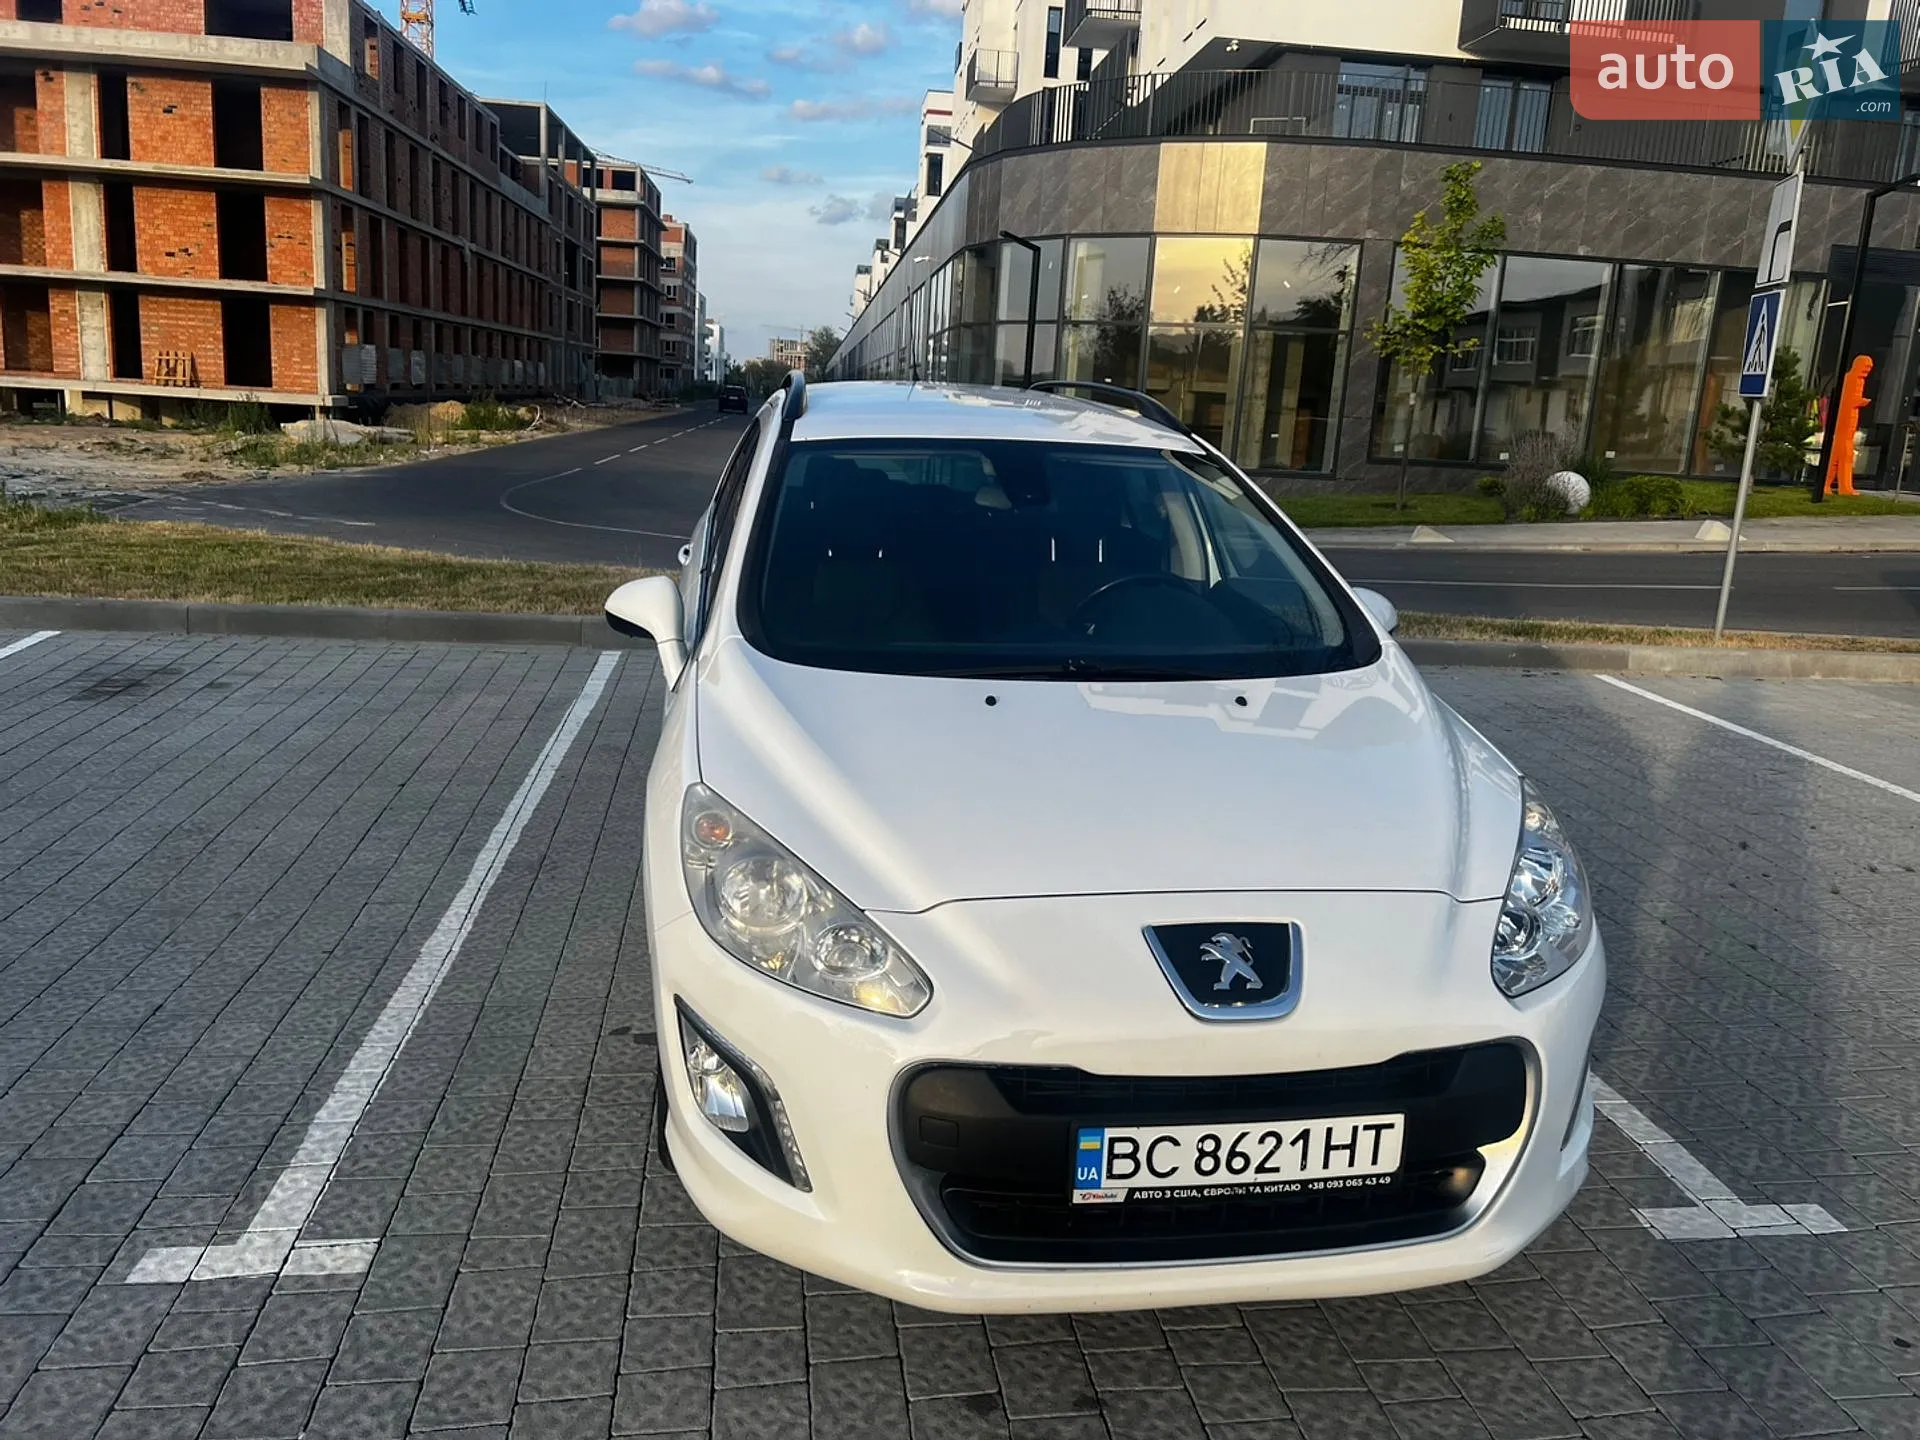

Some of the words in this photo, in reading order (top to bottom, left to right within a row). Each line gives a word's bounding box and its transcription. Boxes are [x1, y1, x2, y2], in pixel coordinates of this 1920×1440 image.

[1106, 1136, 1181, 1180] BC
[1077, 1167, 1098, 1181] UA
[1133, 1190, 1162, 1199] АВТО
[1173, 1189, 1201, 1198] США,
[1264, 1184, 1301, 1193] КИТАЮ
[1308, 1181, 1324, 1190] +38
[1326, 1180, 1344, 1189] 093
[1365, 1177, 1377, 1186] 43
[1379, 1176, 1391, 1184] 49
